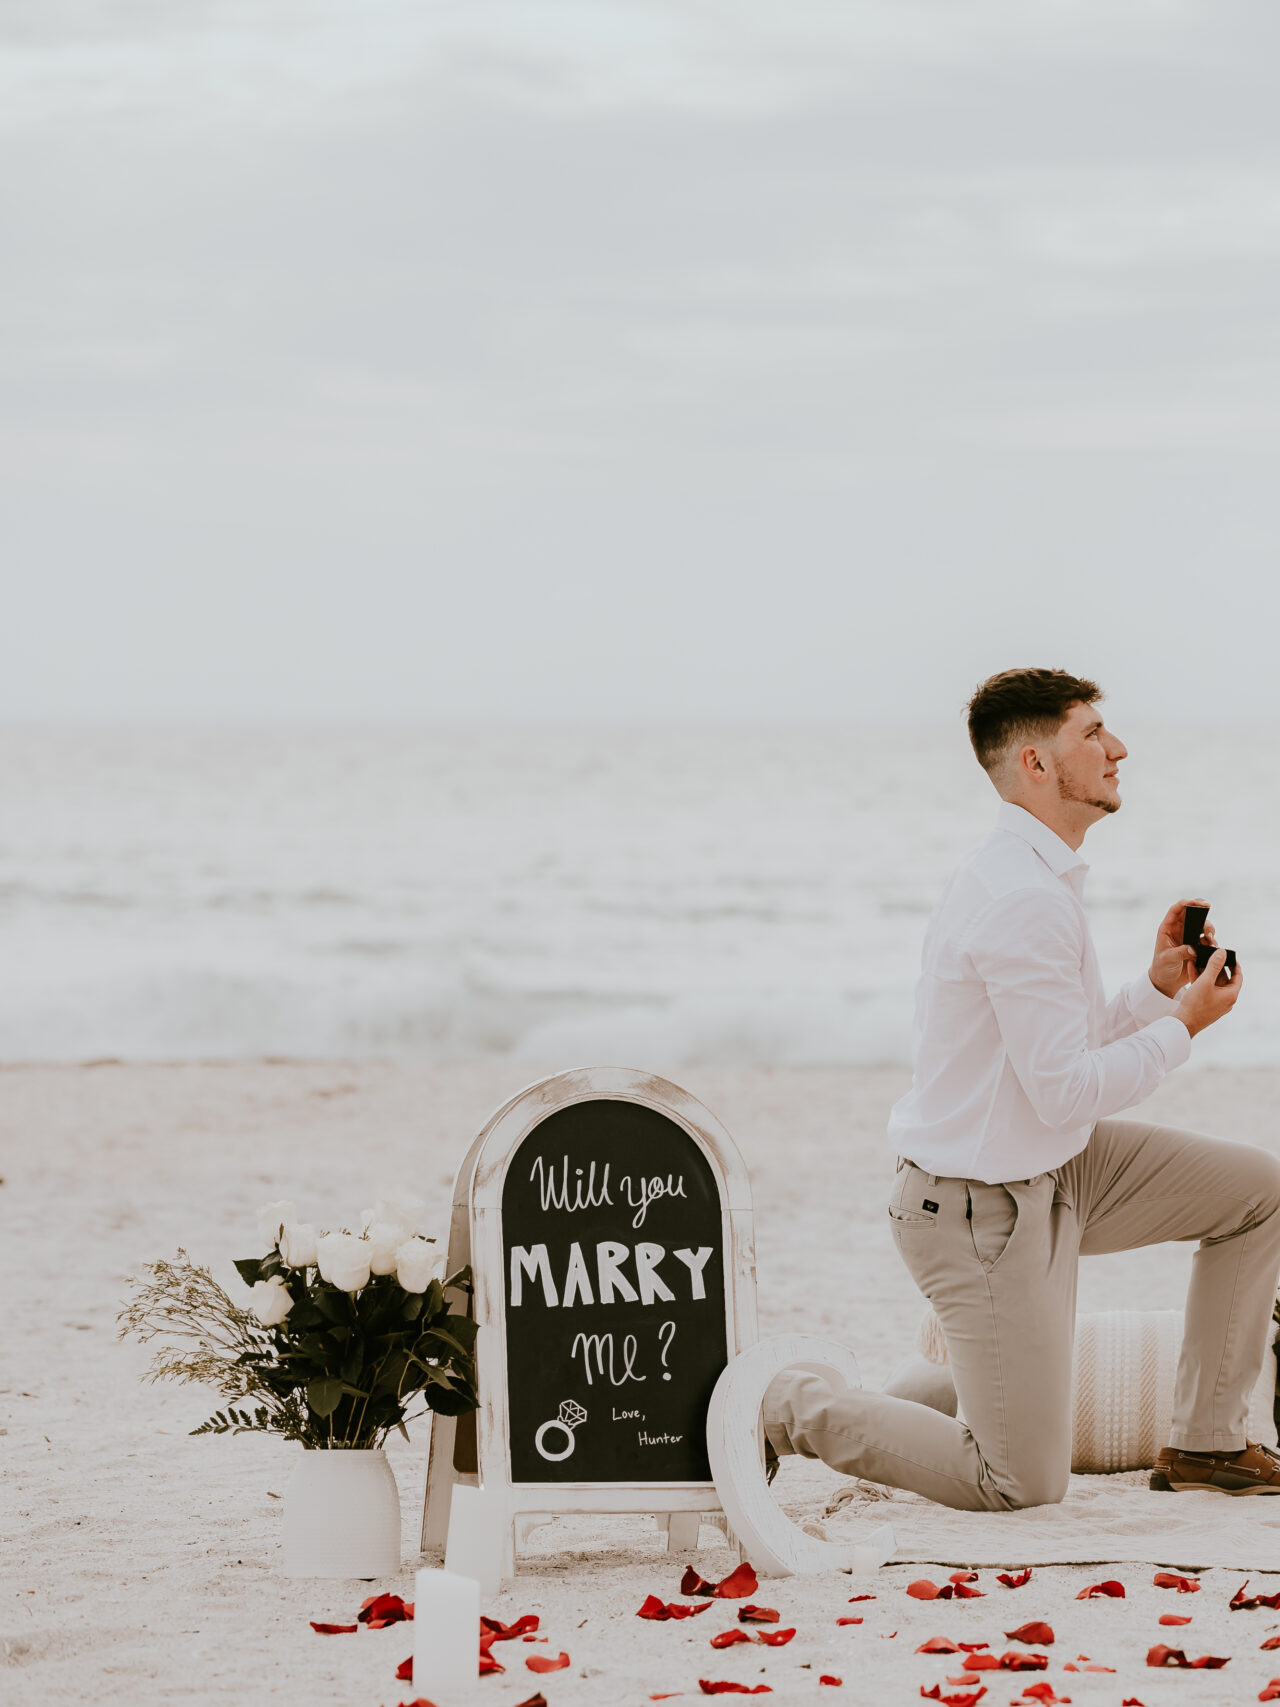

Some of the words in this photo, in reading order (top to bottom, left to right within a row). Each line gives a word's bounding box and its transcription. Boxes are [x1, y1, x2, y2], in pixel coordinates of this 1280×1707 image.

[530, 1154, 614, 1213] Will
[619, 1173, 688, 1229] you
[510, 1240, 714, 1308] MARRY
[612, 1407, 646, 1422] Love,
[638, 1431, 683, 1446] Hunter
